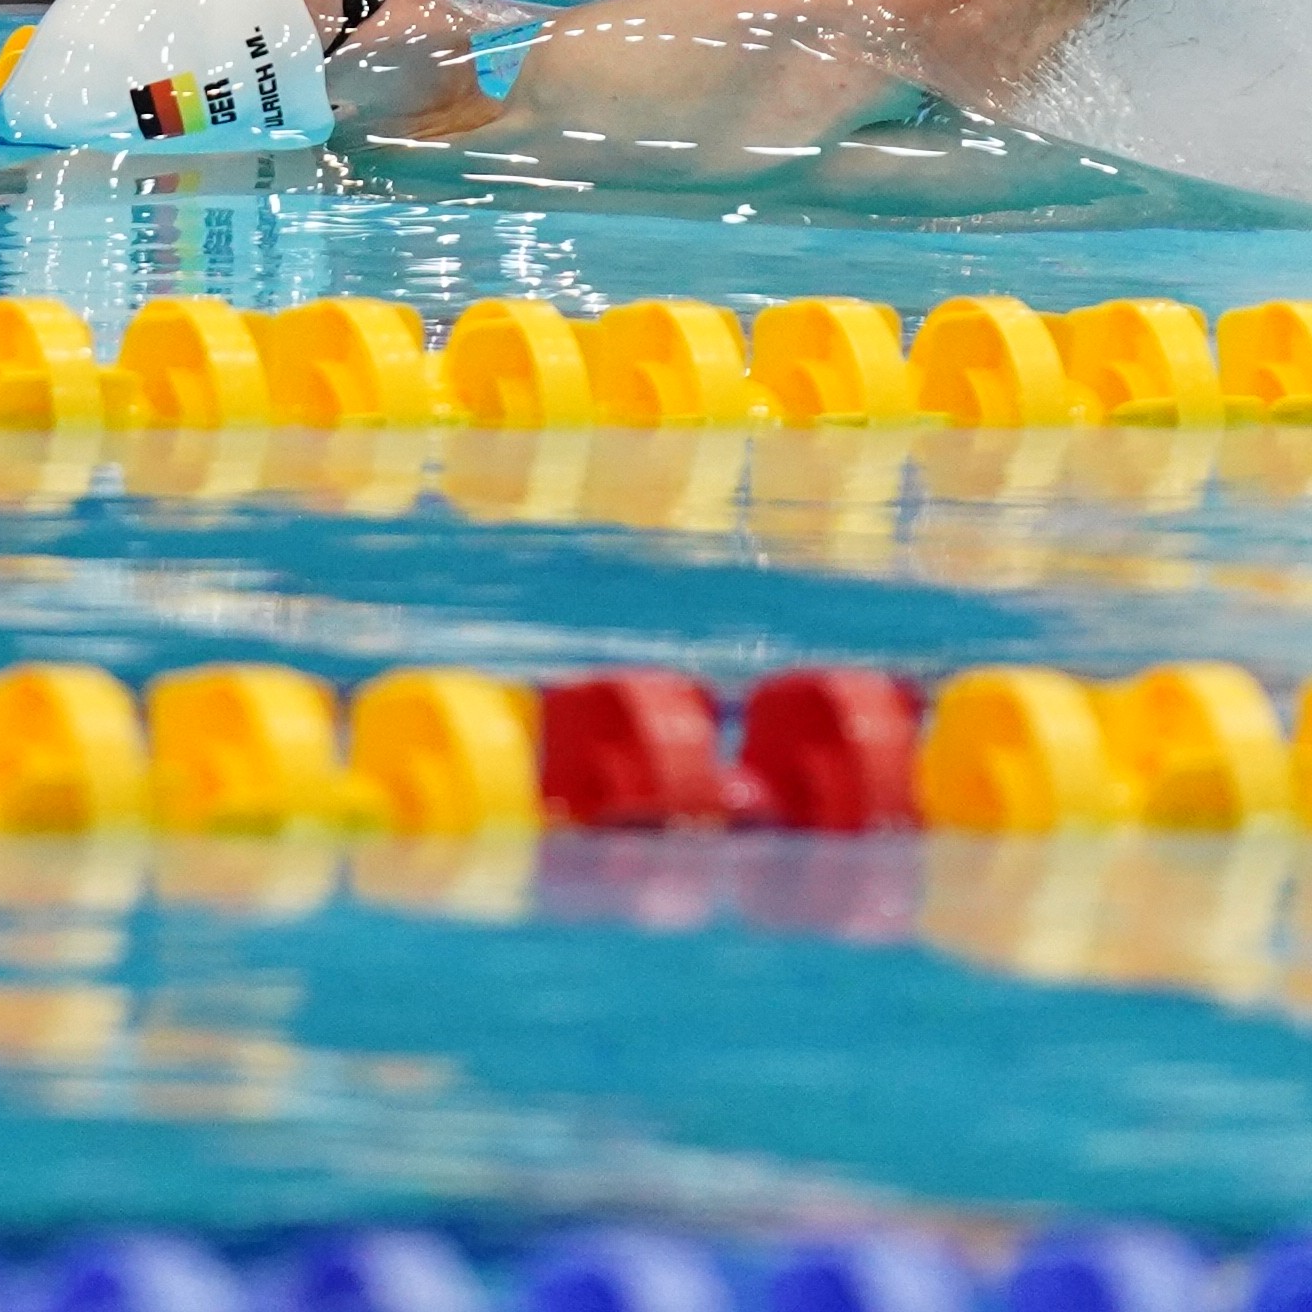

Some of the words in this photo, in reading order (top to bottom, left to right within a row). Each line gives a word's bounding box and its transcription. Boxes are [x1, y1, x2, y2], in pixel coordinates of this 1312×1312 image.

[245, 25, 269, 59] M.
[204, 77, 237, 126] GER
[255, 63, 284, 128] ULRICH
